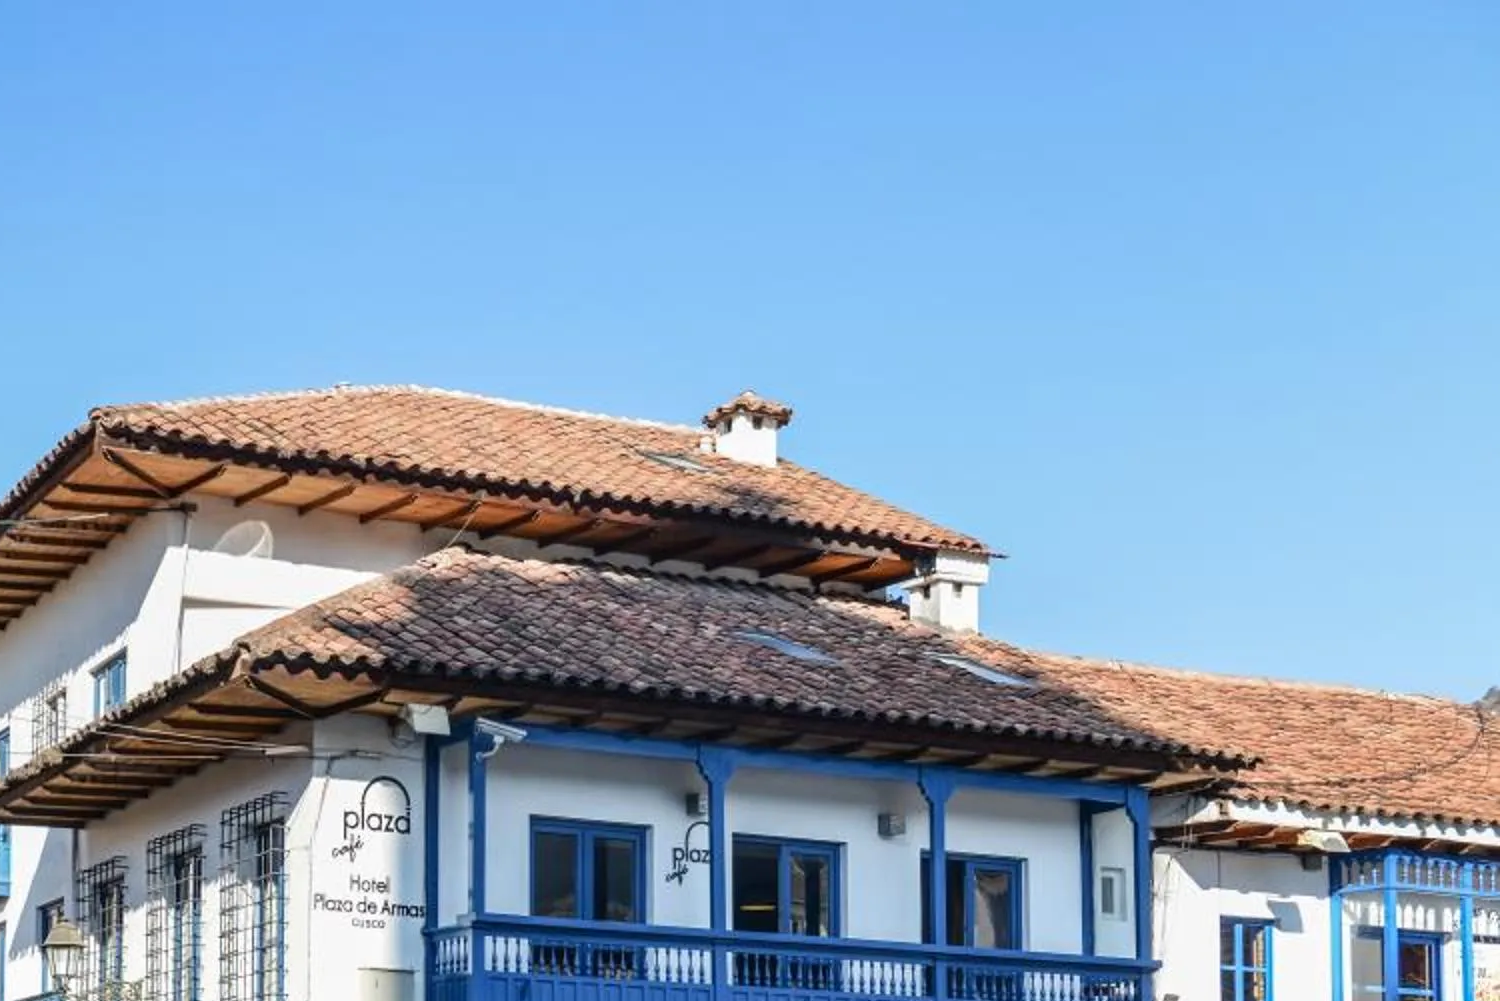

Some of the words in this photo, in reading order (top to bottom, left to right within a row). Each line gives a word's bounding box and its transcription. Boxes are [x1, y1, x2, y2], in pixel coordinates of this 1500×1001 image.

[343, 798, 411, 839] plaza
[672, 837, 710, 870] plaz
[349, 873, 391, 893] Hotel
[313, 893, 353, 913] Plaza
[356, 896, 378, 914] de
[380, 900, 427, 918] Armas
